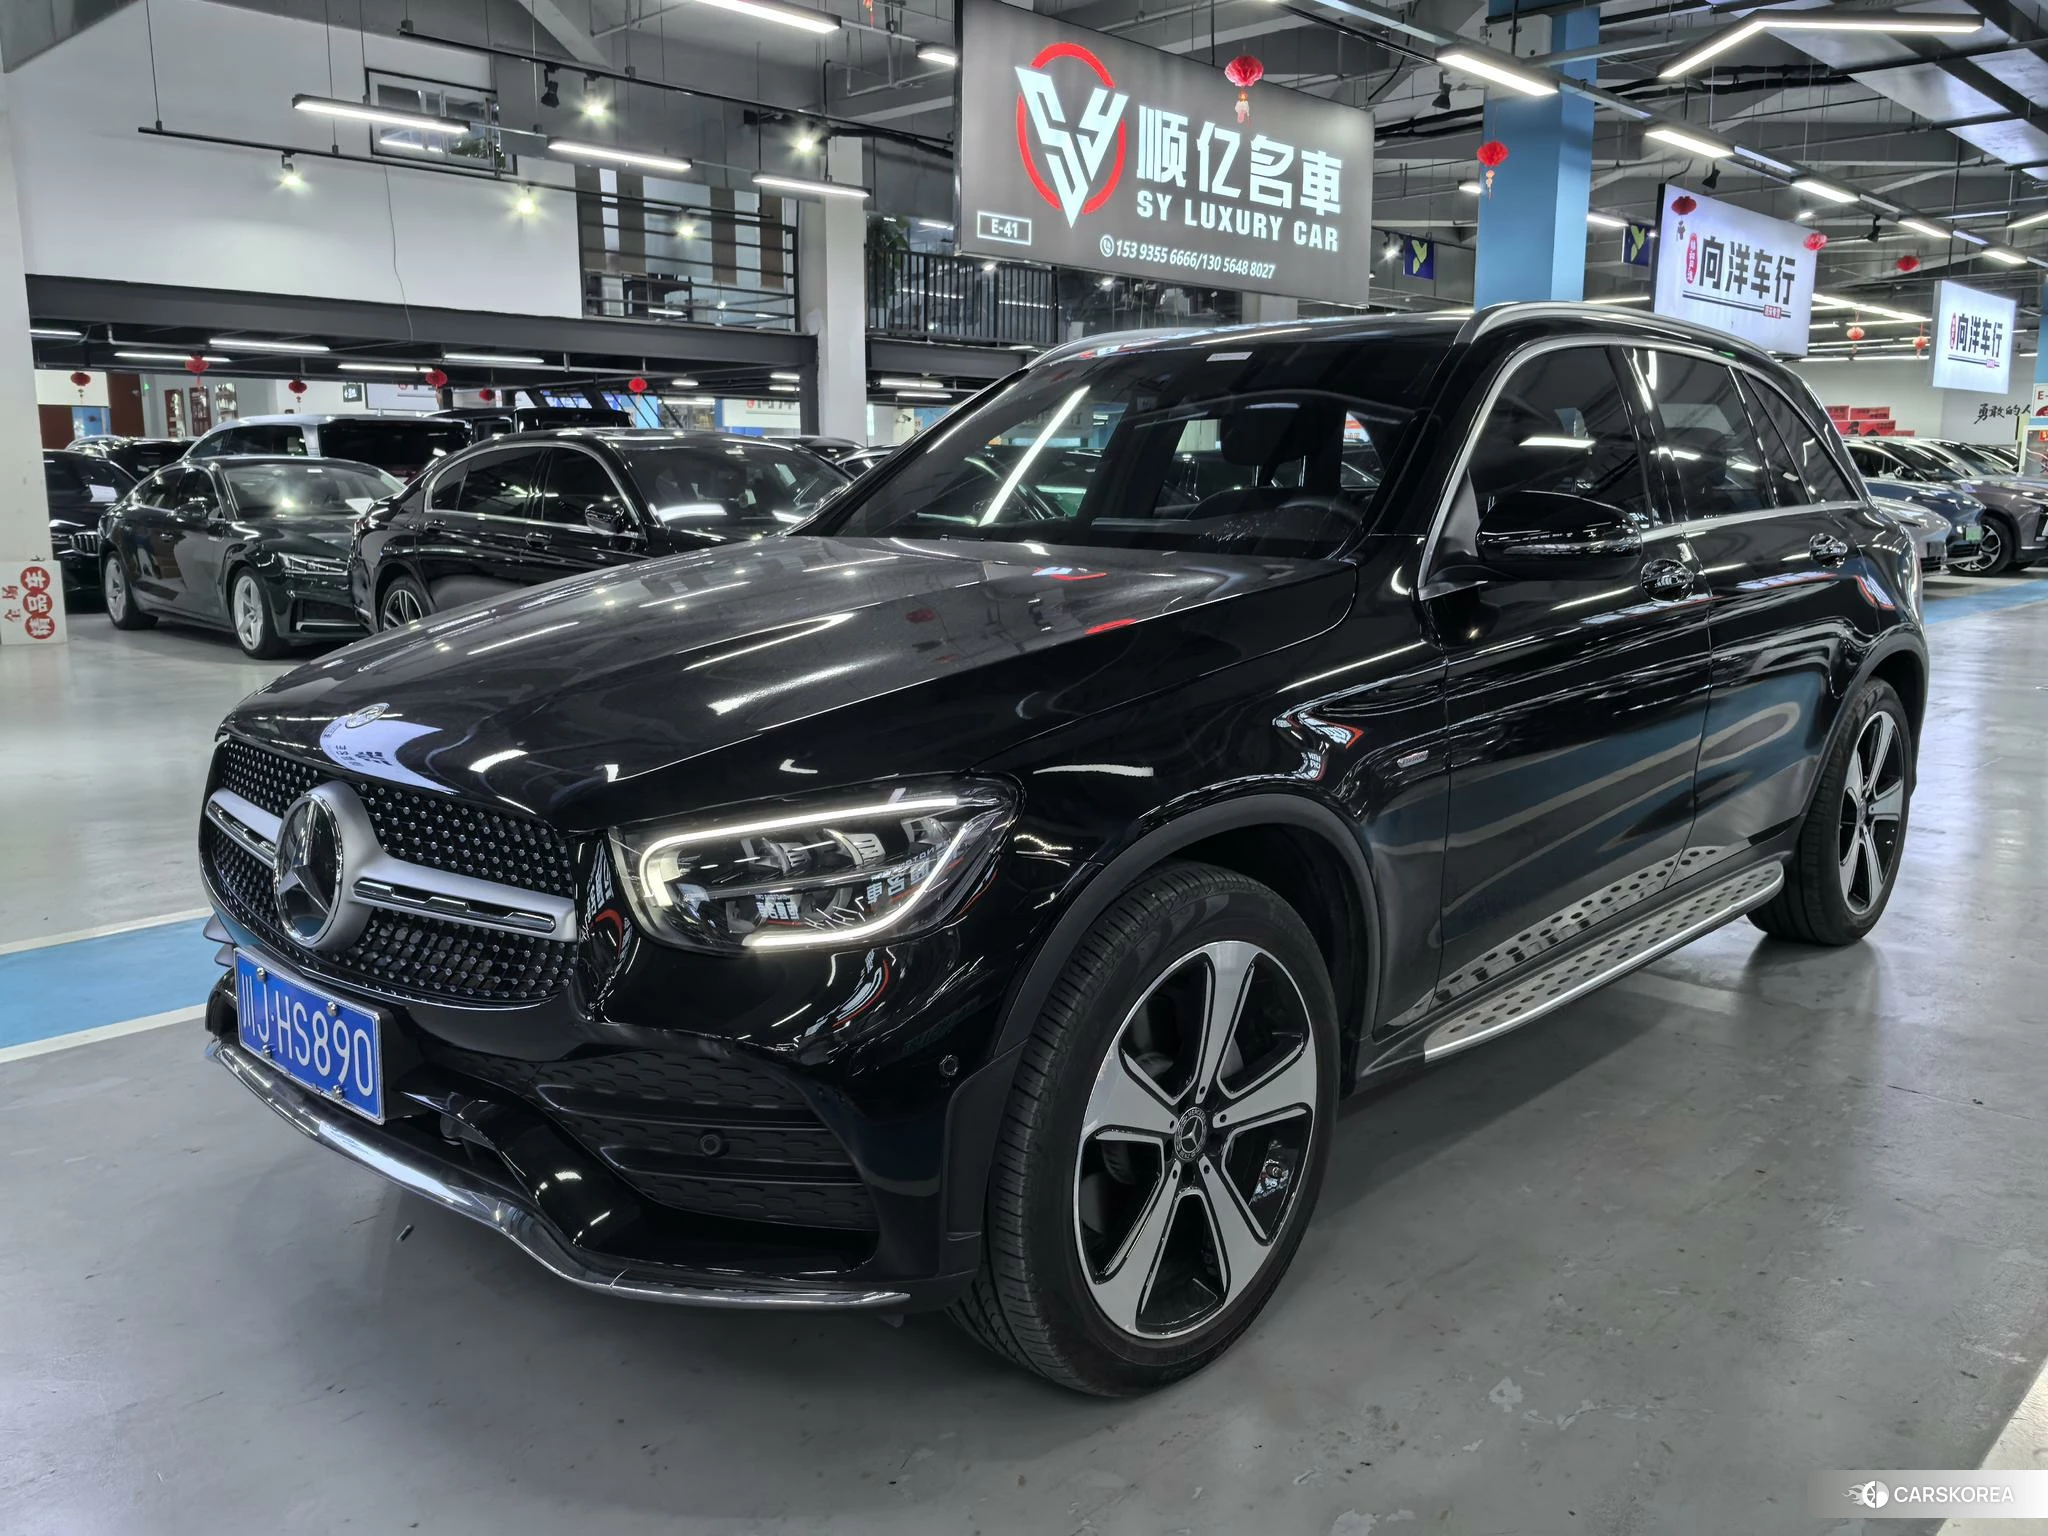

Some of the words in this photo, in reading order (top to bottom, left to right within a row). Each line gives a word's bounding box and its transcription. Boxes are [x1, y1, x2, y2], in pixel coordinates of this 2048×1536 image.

[1136, 105, 1342, 217] 顺亿名車
[991, 214, 1020, 239] E-41
[1136, 190, 1171, 221] SY
[1185, 198, 1283, 242] LUXURY
[1293, 223, 1338, 252] CAR
[1116, 240, 1137, 259] 153
[1139, 243, 1168, 262] 9355
[1170, 247, 1221, 272] 6666/130
[1223, 257, 1249, 275] 5648
[1250, 260, 1276, 280] 8027
[1699, 236, 1796, 305] 向洋车行
[1955, 313, 2003, 358] 向洋车行
